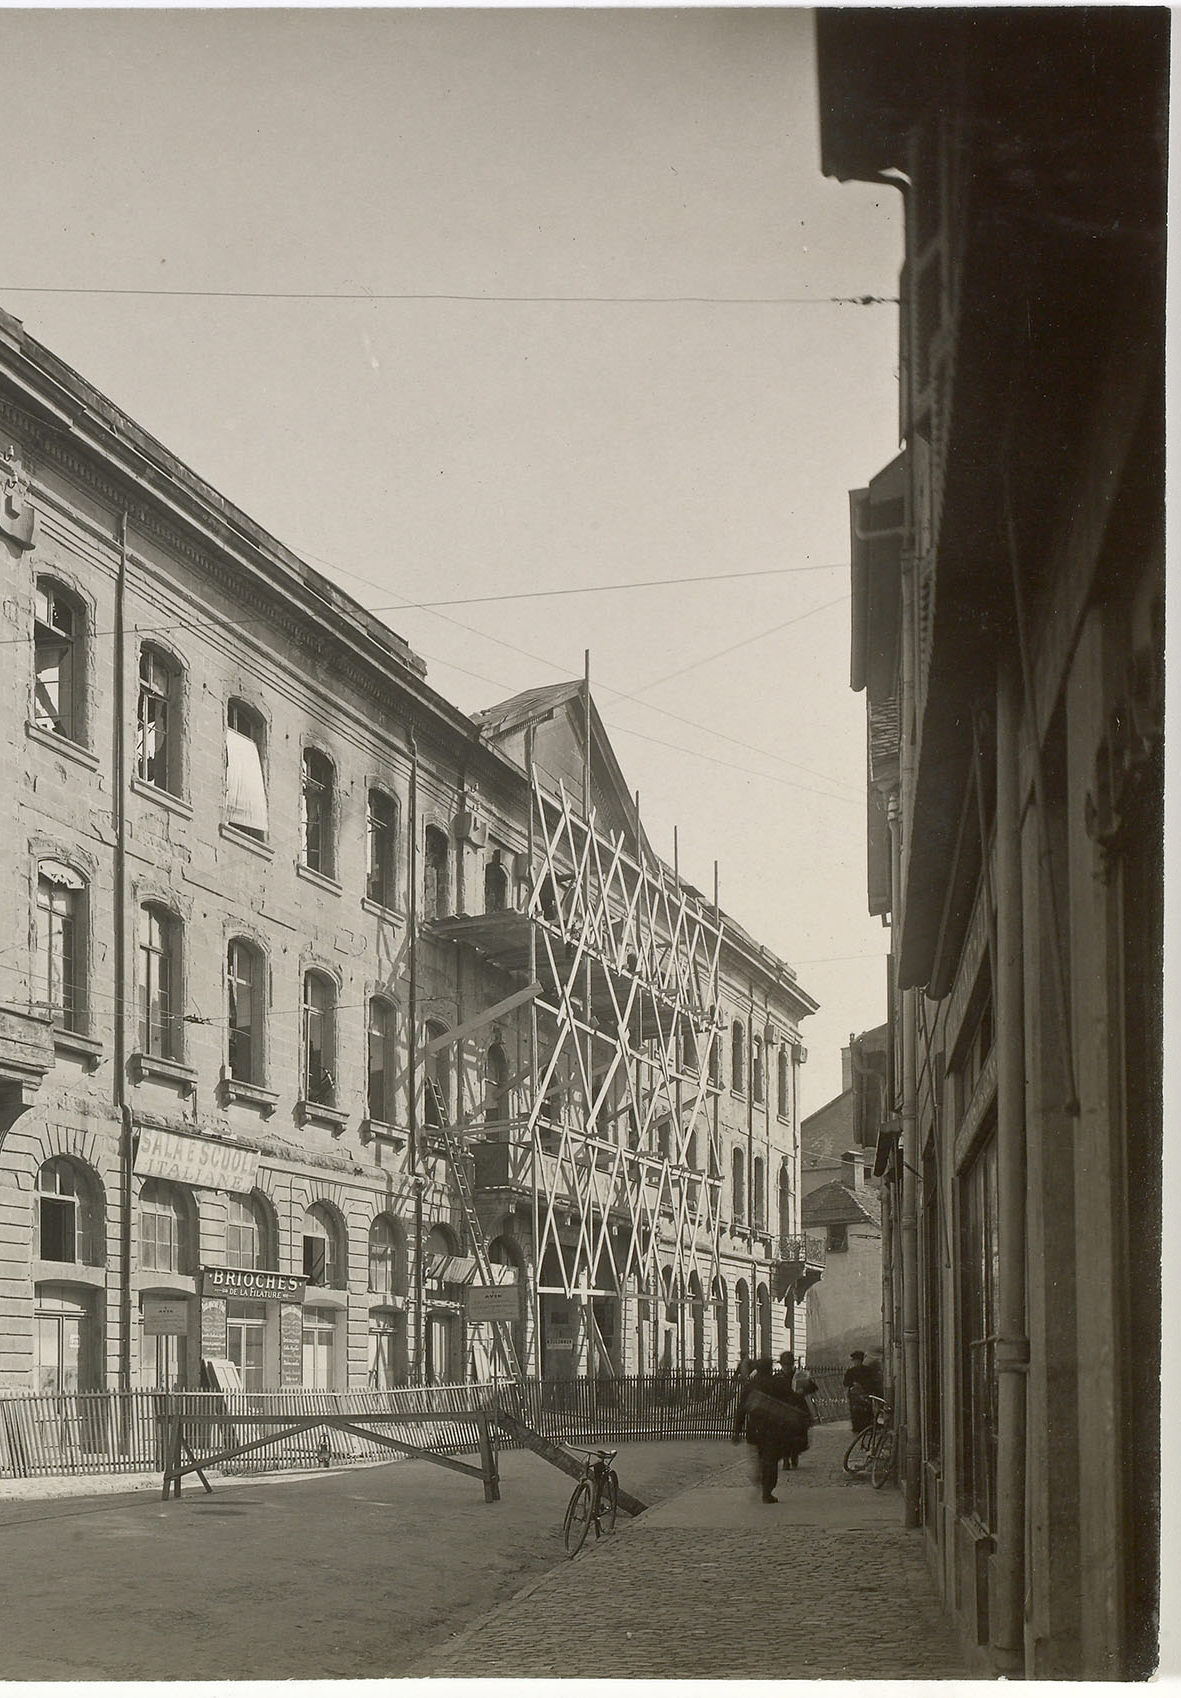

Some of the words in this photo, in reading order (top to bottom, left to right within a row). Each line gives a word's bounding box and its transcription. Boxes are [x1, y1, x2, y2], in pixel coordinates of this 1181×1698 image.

[146, 1159, 244, 1189] ITALIANE
[213, 1270, 298, 1291] BRIOCHES
[240, 1288, 249, 1297] LA
